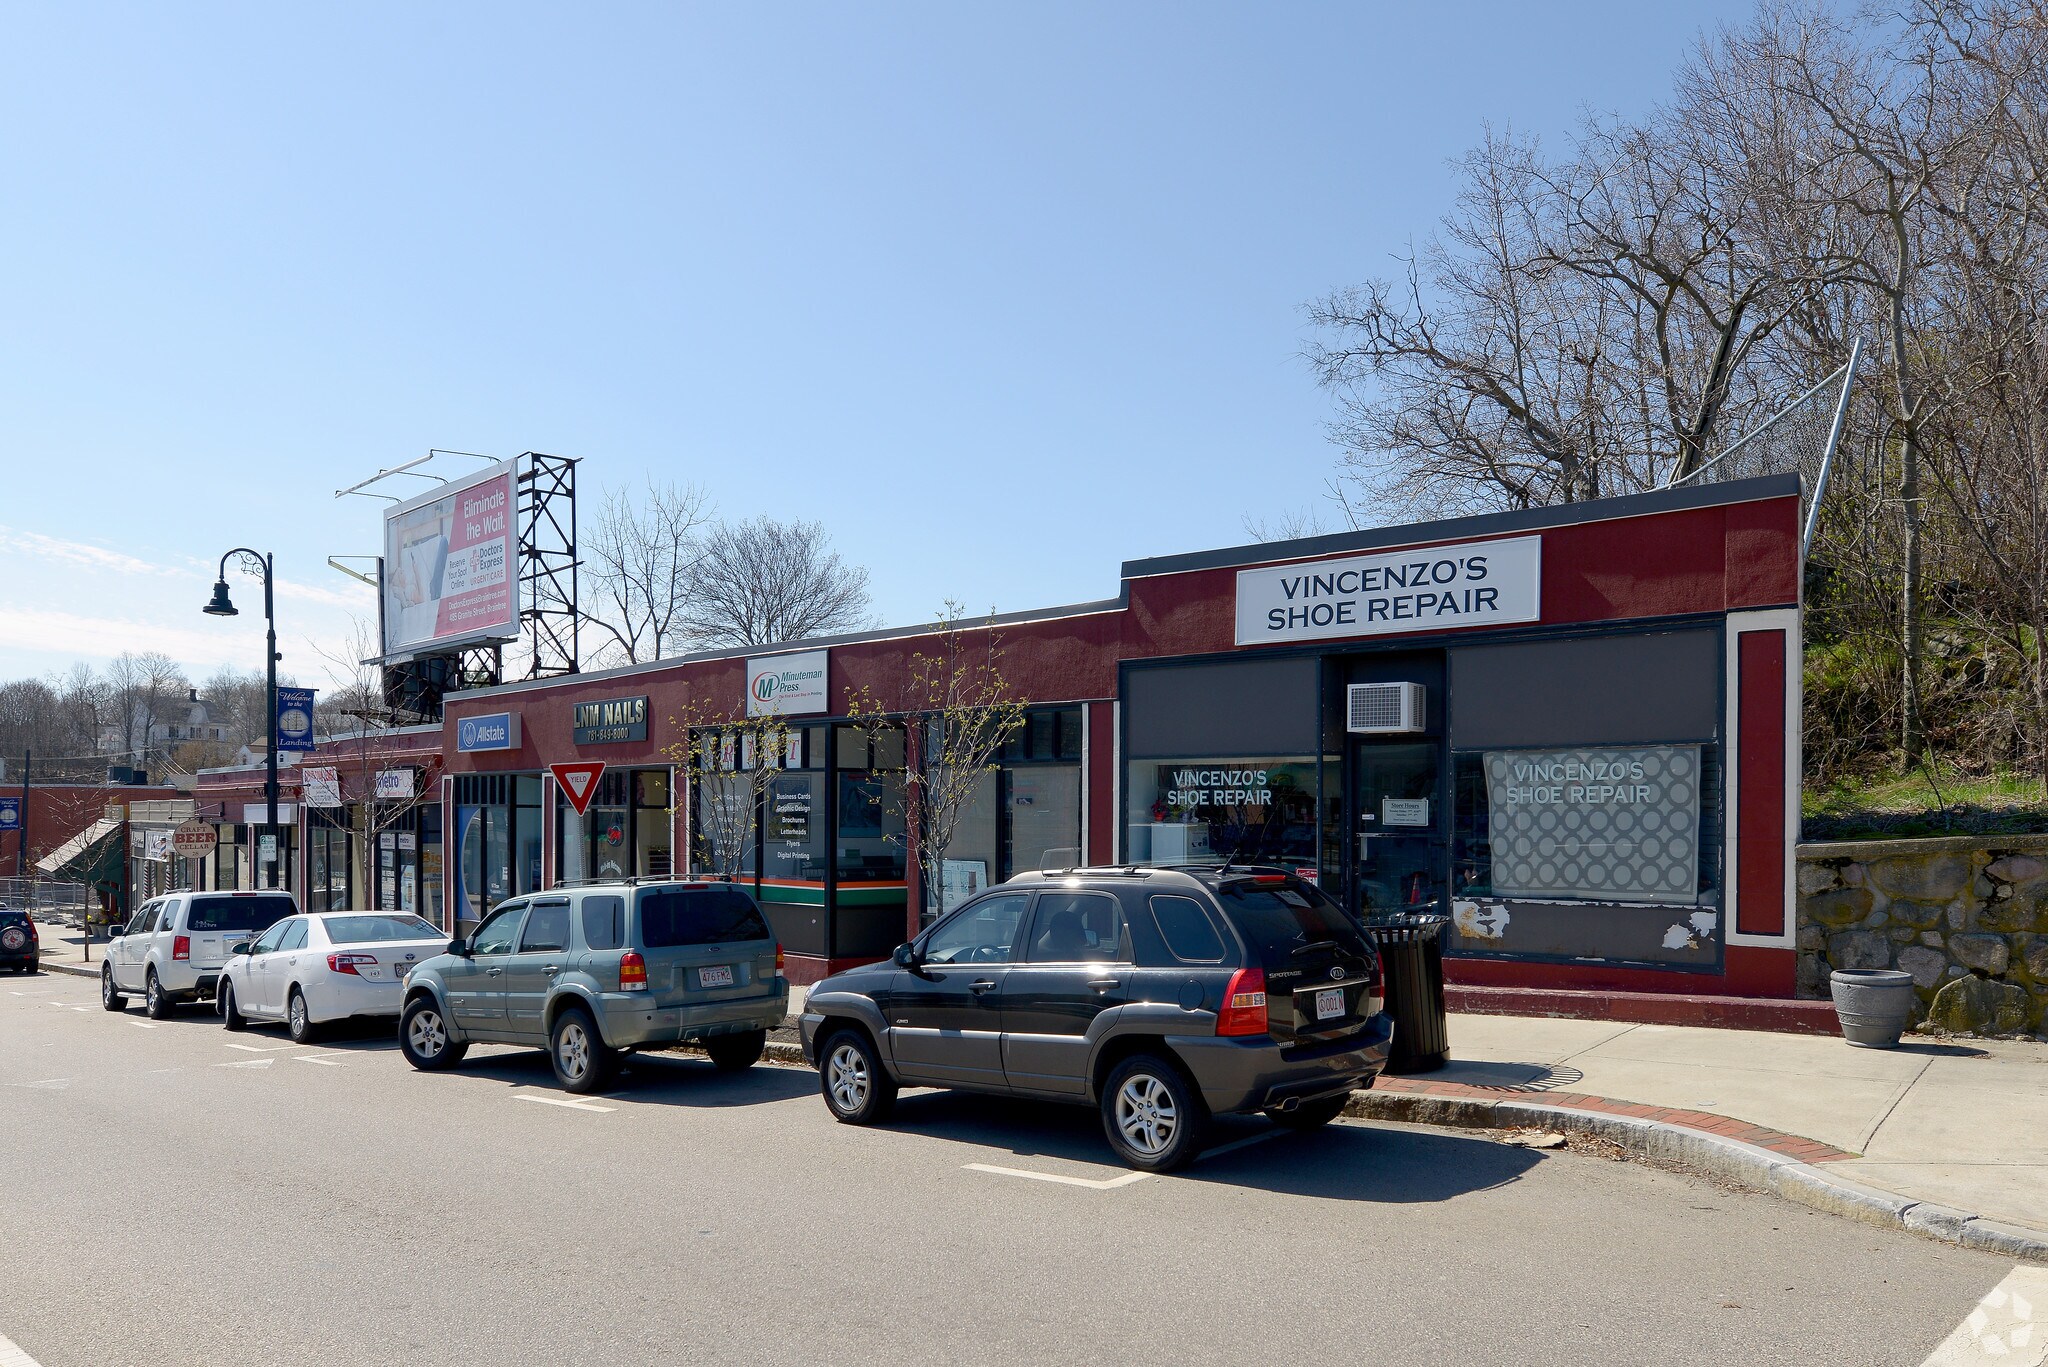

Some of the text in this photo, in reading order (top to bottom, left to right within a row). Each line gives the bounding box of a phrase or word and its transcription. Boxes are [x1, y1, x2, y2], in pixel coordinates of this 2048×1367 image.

[464, 489, 505, 518] Eliminate
[466, 511, 506, 540] the Wait.
[480, 544, 502, 558] Doctors
[450, 558, 466, 569] Reserve
[480, 556, 503, 570] Express
[470, 570, 504, 586] URGENT CARE
[1280, 556, 1488, 600] VINCENZO'S
[1267, 587, 1500, 631] SHOE REPAIR
[781, 670, 822, 682] Minuteman
[780, 682, 800, 692] Press
[279, 692, 312, 701] Welcome
[574, 700, 644, 729] LNM NAILS
[476, 725, 505, 742] Allstate
[280, 738, 312, 747] Landing
[1173, 770, 1267, 786] VINCENZO'S
[1514, 762, 1644, 782] VINCENZO'S
[1168, 790, 1272, 806] SHOE REPAIR
[1506, 785, 1651, 804] SHOE REPAIR
[175, 833, 215, 843] BEER
[792, 852, 810, 860] Printing
[1269, 970, 1302, 979] SPORTAGE
[1332, 968, 1342, 977] KIA
